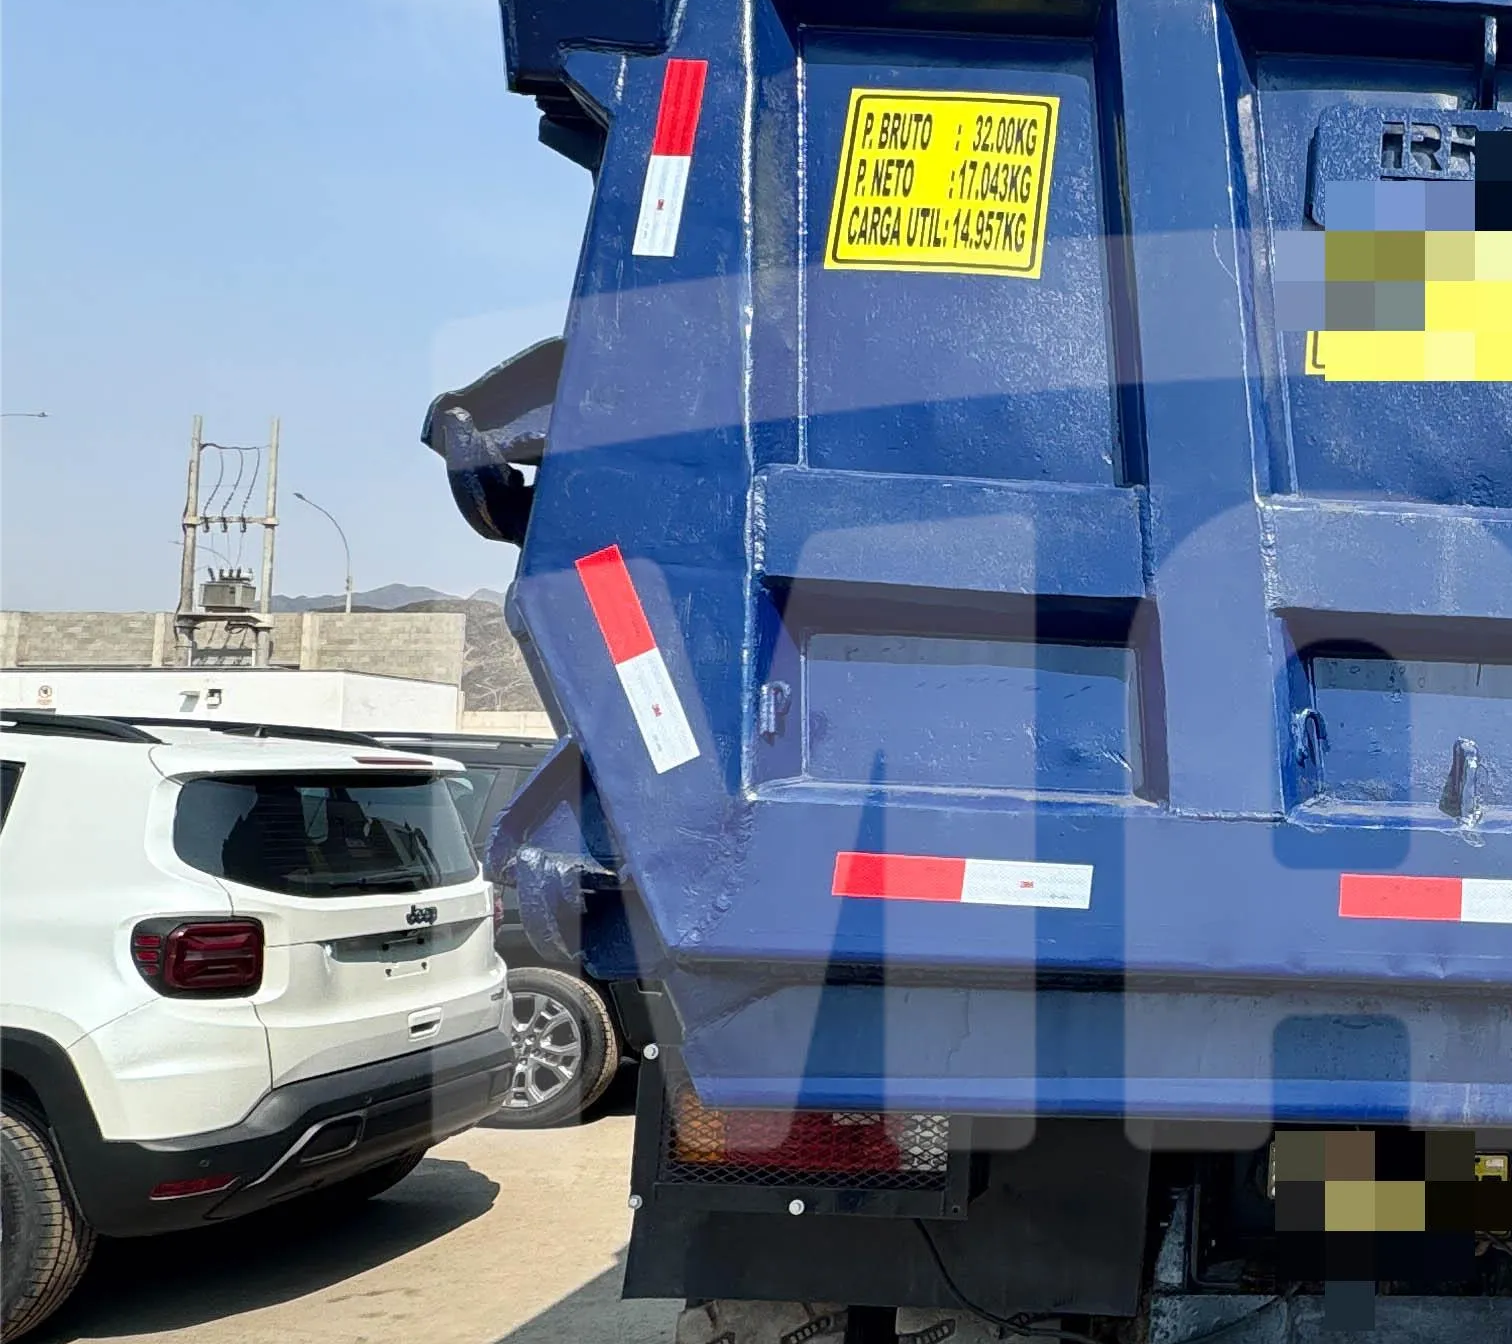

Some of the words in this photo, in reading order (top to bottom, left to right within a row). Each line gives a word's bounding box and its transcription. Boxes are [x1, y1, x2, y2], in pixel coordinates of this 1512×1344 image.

[878, 112, 933, 151] BRUTO
[972, 115, 1038, 156] 32.00KG
[870, 159, 915, 197] NETO
[847, 206, 901, 246] CARGA
